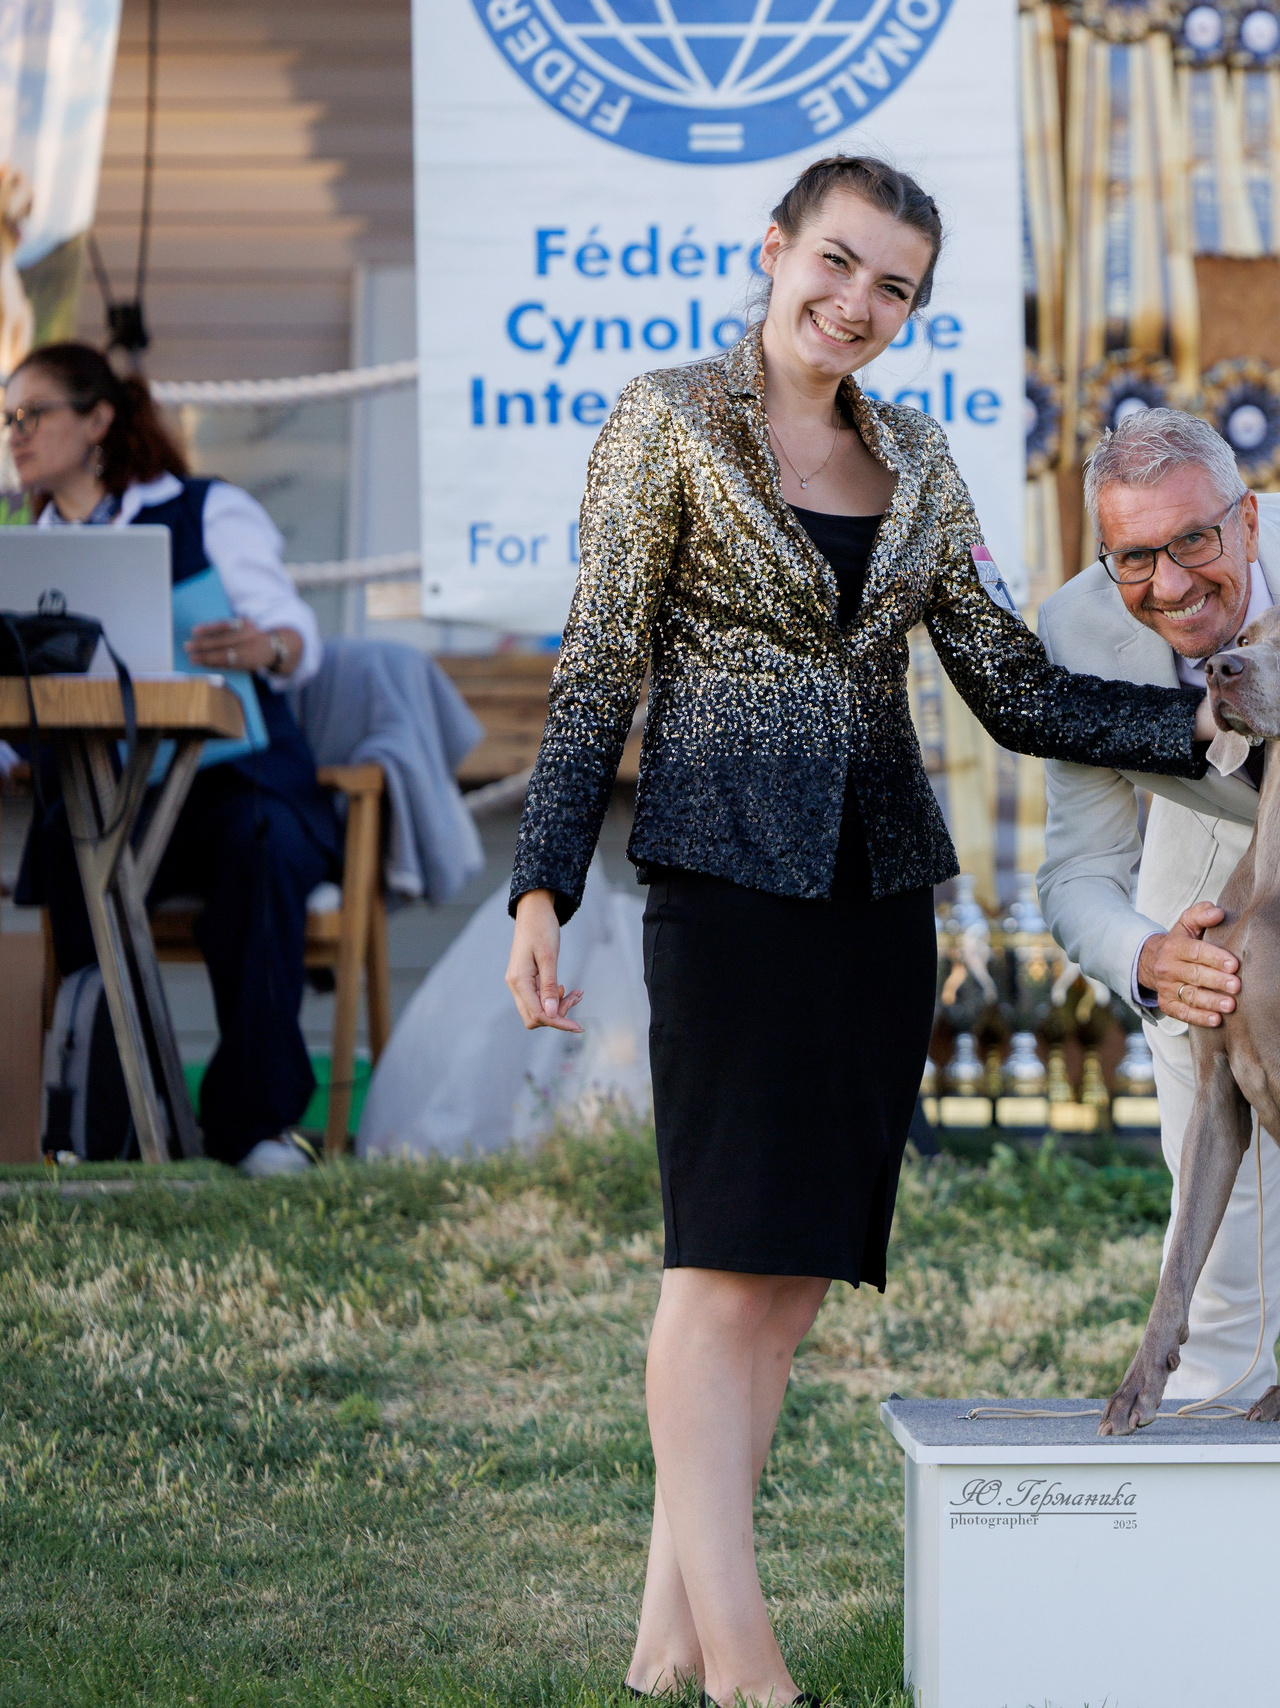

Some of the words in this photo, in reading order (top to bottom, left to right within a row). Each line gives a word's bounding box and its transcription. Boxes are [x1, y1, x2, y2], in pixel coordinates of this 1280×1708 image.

[506, 300, 961, 366] Cynoloue
[471, 372, 1001, 426] Inteale
[469, 521, 548, 566] For
